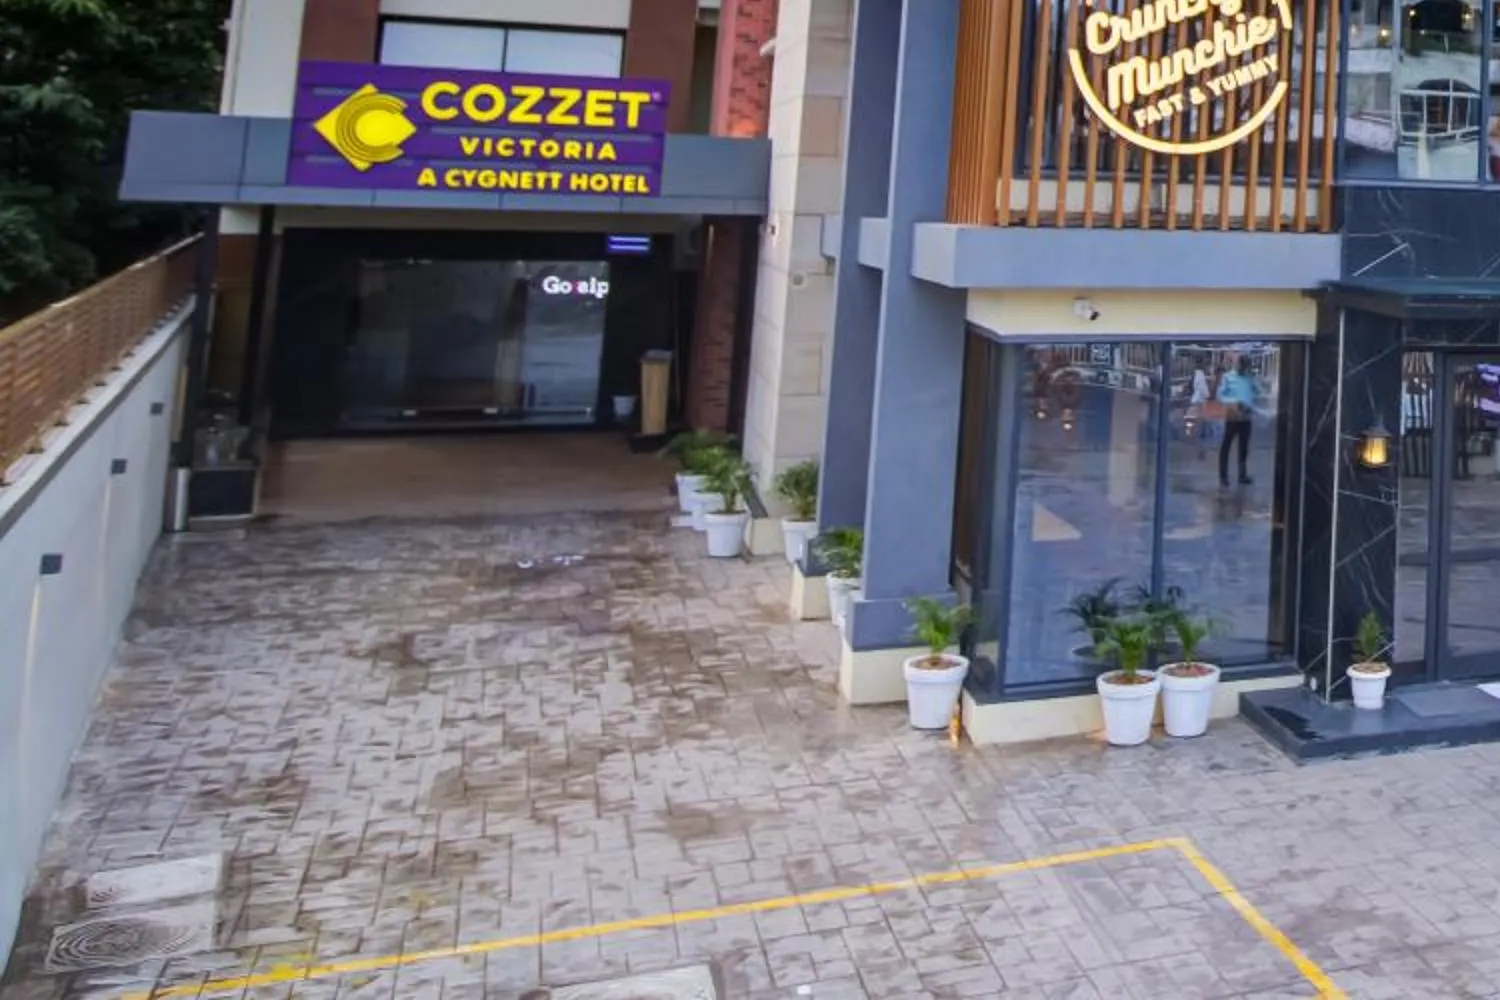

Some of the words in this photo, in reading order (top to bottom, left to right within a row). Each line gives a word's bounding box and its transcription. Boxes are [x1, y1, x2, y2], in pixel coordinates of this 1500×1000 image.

[421, 81, 651, 129] COZZET
[1133, 93, 1184, 128] FAST
[1189, 87, 1207, 105] &
[1206, 54, 1278, 96] YUMMY
[459, 136, 617, 161] VICTORIA
[416, 167, 437, 188] A
[444, 168, 563, 191] CYGNETT
[569, 171, 651, 194] HOTEL
